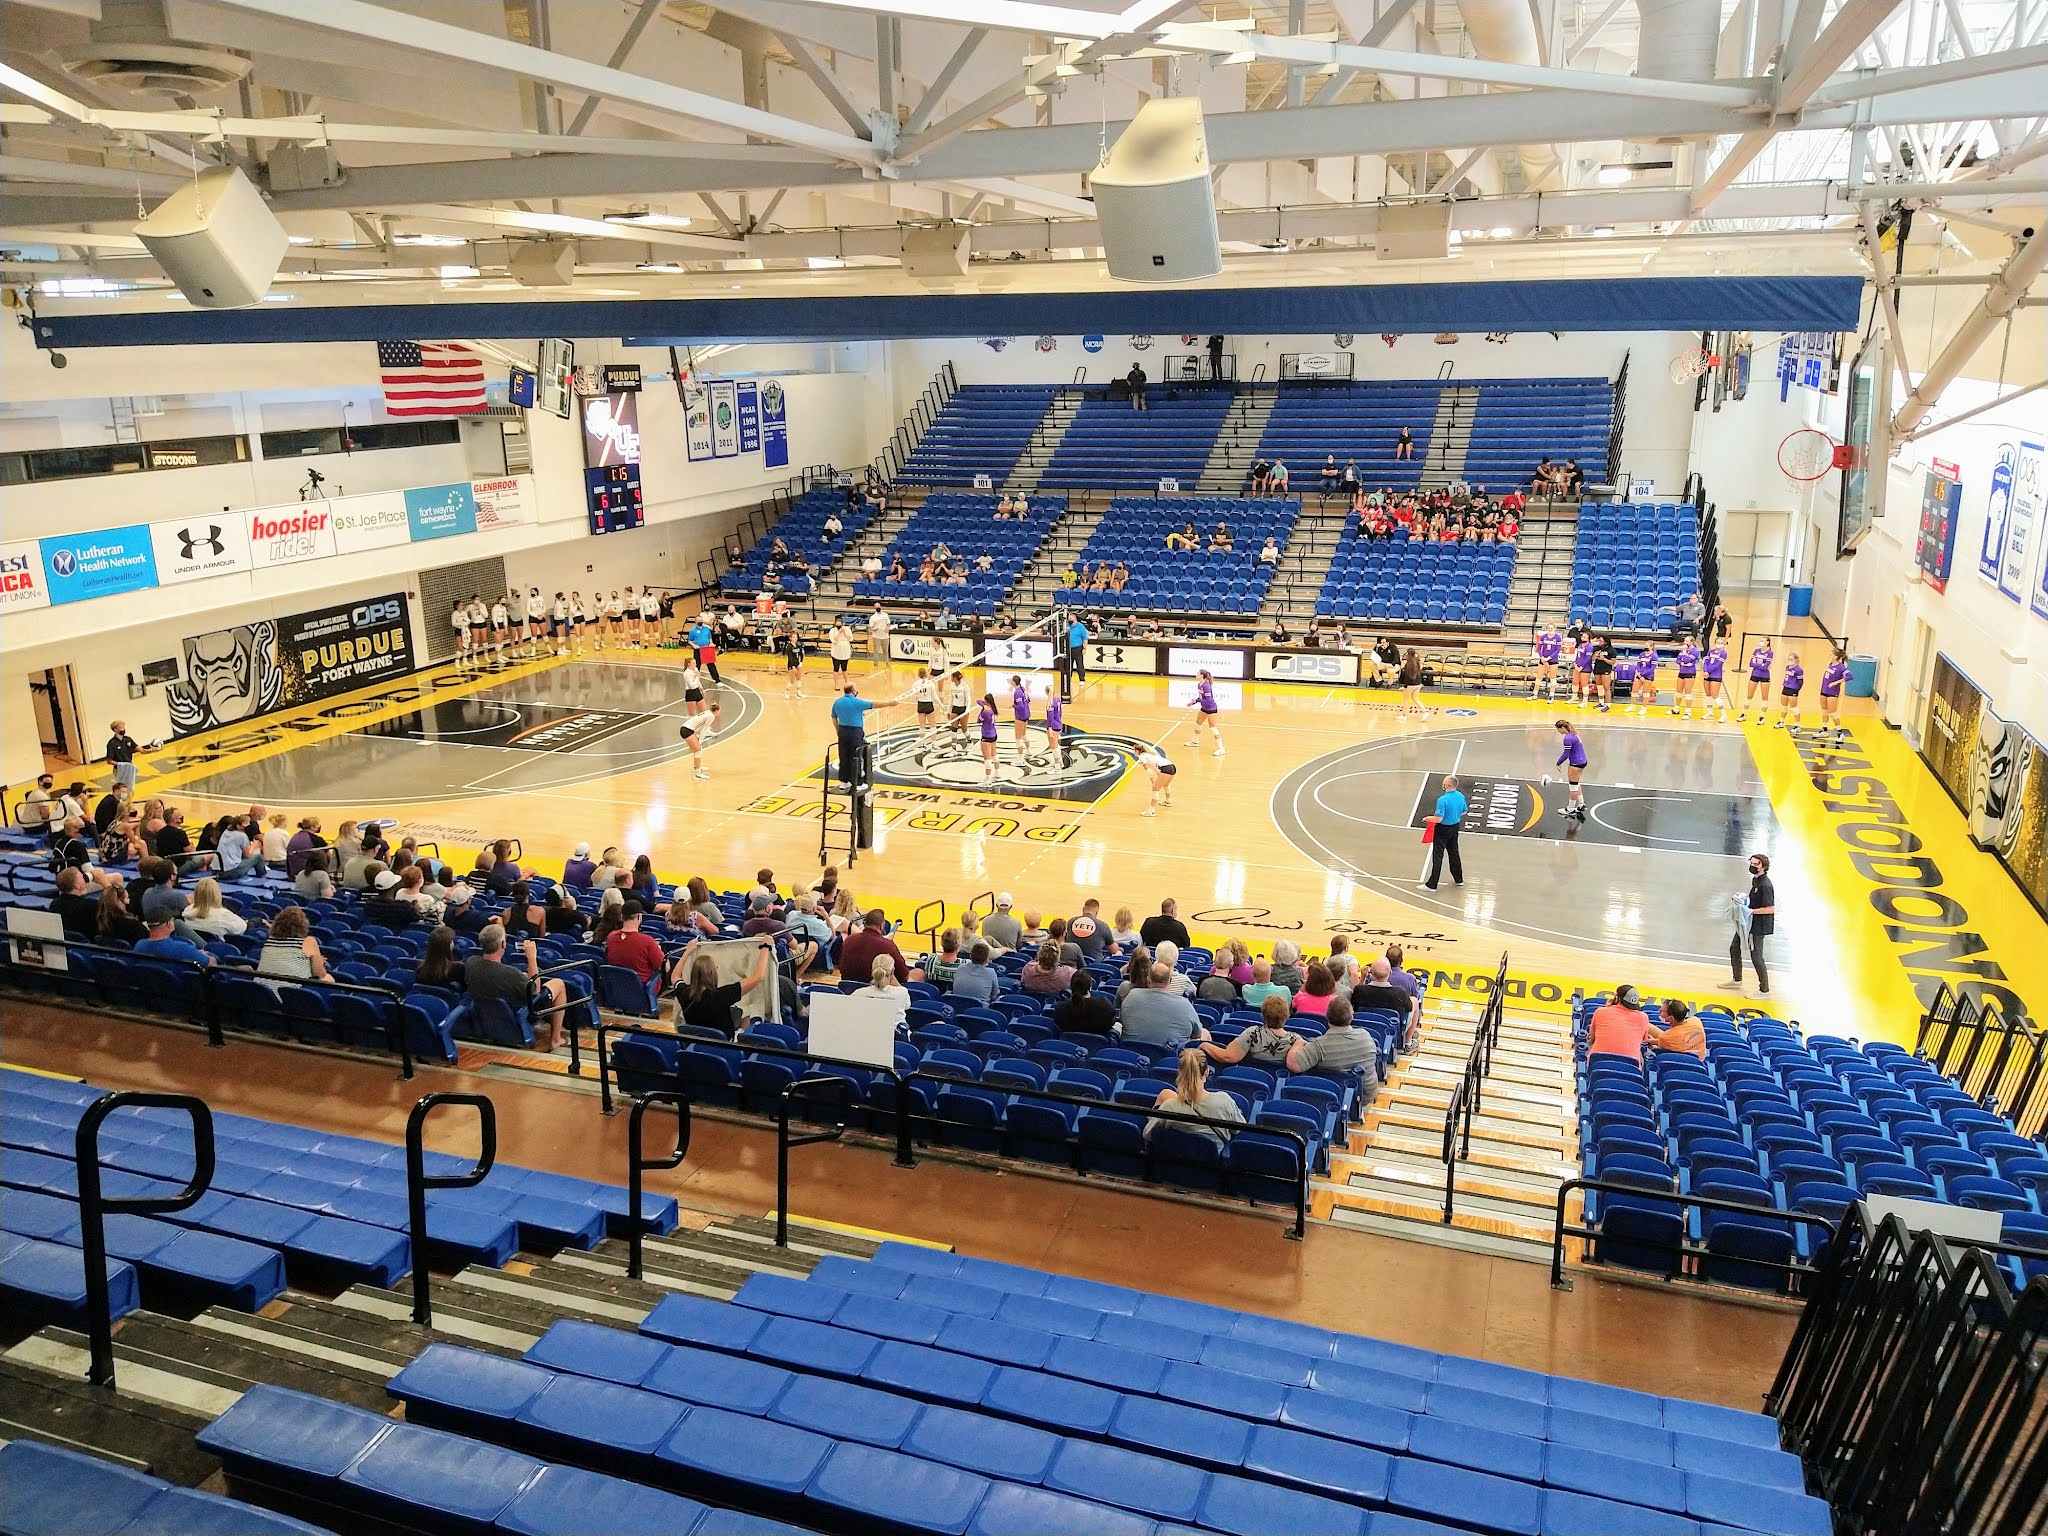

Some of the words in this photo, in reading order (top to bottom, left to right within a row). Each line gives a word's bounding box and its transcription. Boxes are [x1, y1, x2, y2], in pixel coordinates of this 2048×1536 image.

[1085, 340, 1104, 348] NCAA
[608, 371, 639, 381] PURDUE
[741, 405, 756, 415] NCAA
[693, 441, 709, 451] 2014
[719, 438, 733, 448] 2011
[473, 480, 518, 493] GLENBROOK
[978, 479, 988, 487] 101
[1162, 482, 1175, 491] 102
[634, 489, 641, 502] 9
[1634, 486, 1650, 496] 104
[601, 494, 609, 508] 6
[419, 507, 433, 518] fort
[433, 504, 455, 516] wayne
[636, 508, 643, 520] 0
[252, 508, 329, 541] hoosier
[346, 516, 358, 529] St.
[359, 513, 377, 527] Joe
[378, 511, 406, 523] Place
[420, 513, 457, 524] ORTHOPEDICS
[597, 515, 604, 527] 0
[77, 544, 125, 561] Lutheran
[269, 531, 317, 561] ride!
[79, 557, 110, 573] Health
[109, 553, 147, 569] Network
[175, 566, 201, 574] UNDER
[203, 559, 236, 571] ARMOUR
[352, 600, 401, 626] OPS
[301, 628, 406, 674] PURDUE
[321, 664, 354, 684] FORT
[353, 654, 393, 675] WAYNE
[1181, 658, 1232, 666] DIAMOND
[1272, 655, 1341, 676] OPS
[517, 714, 607, 745] HORIZON
[950, 796, 1048, 814] FORT
[1464, 781, 1490, 827] LEAGUE
[1486, 783, 1520, 830] HORIZON
[403, 822, 478, 836] Lutheran
[1074, 922, 1094, 931] YETI
[1354, 938, 1436, 953] COURT
